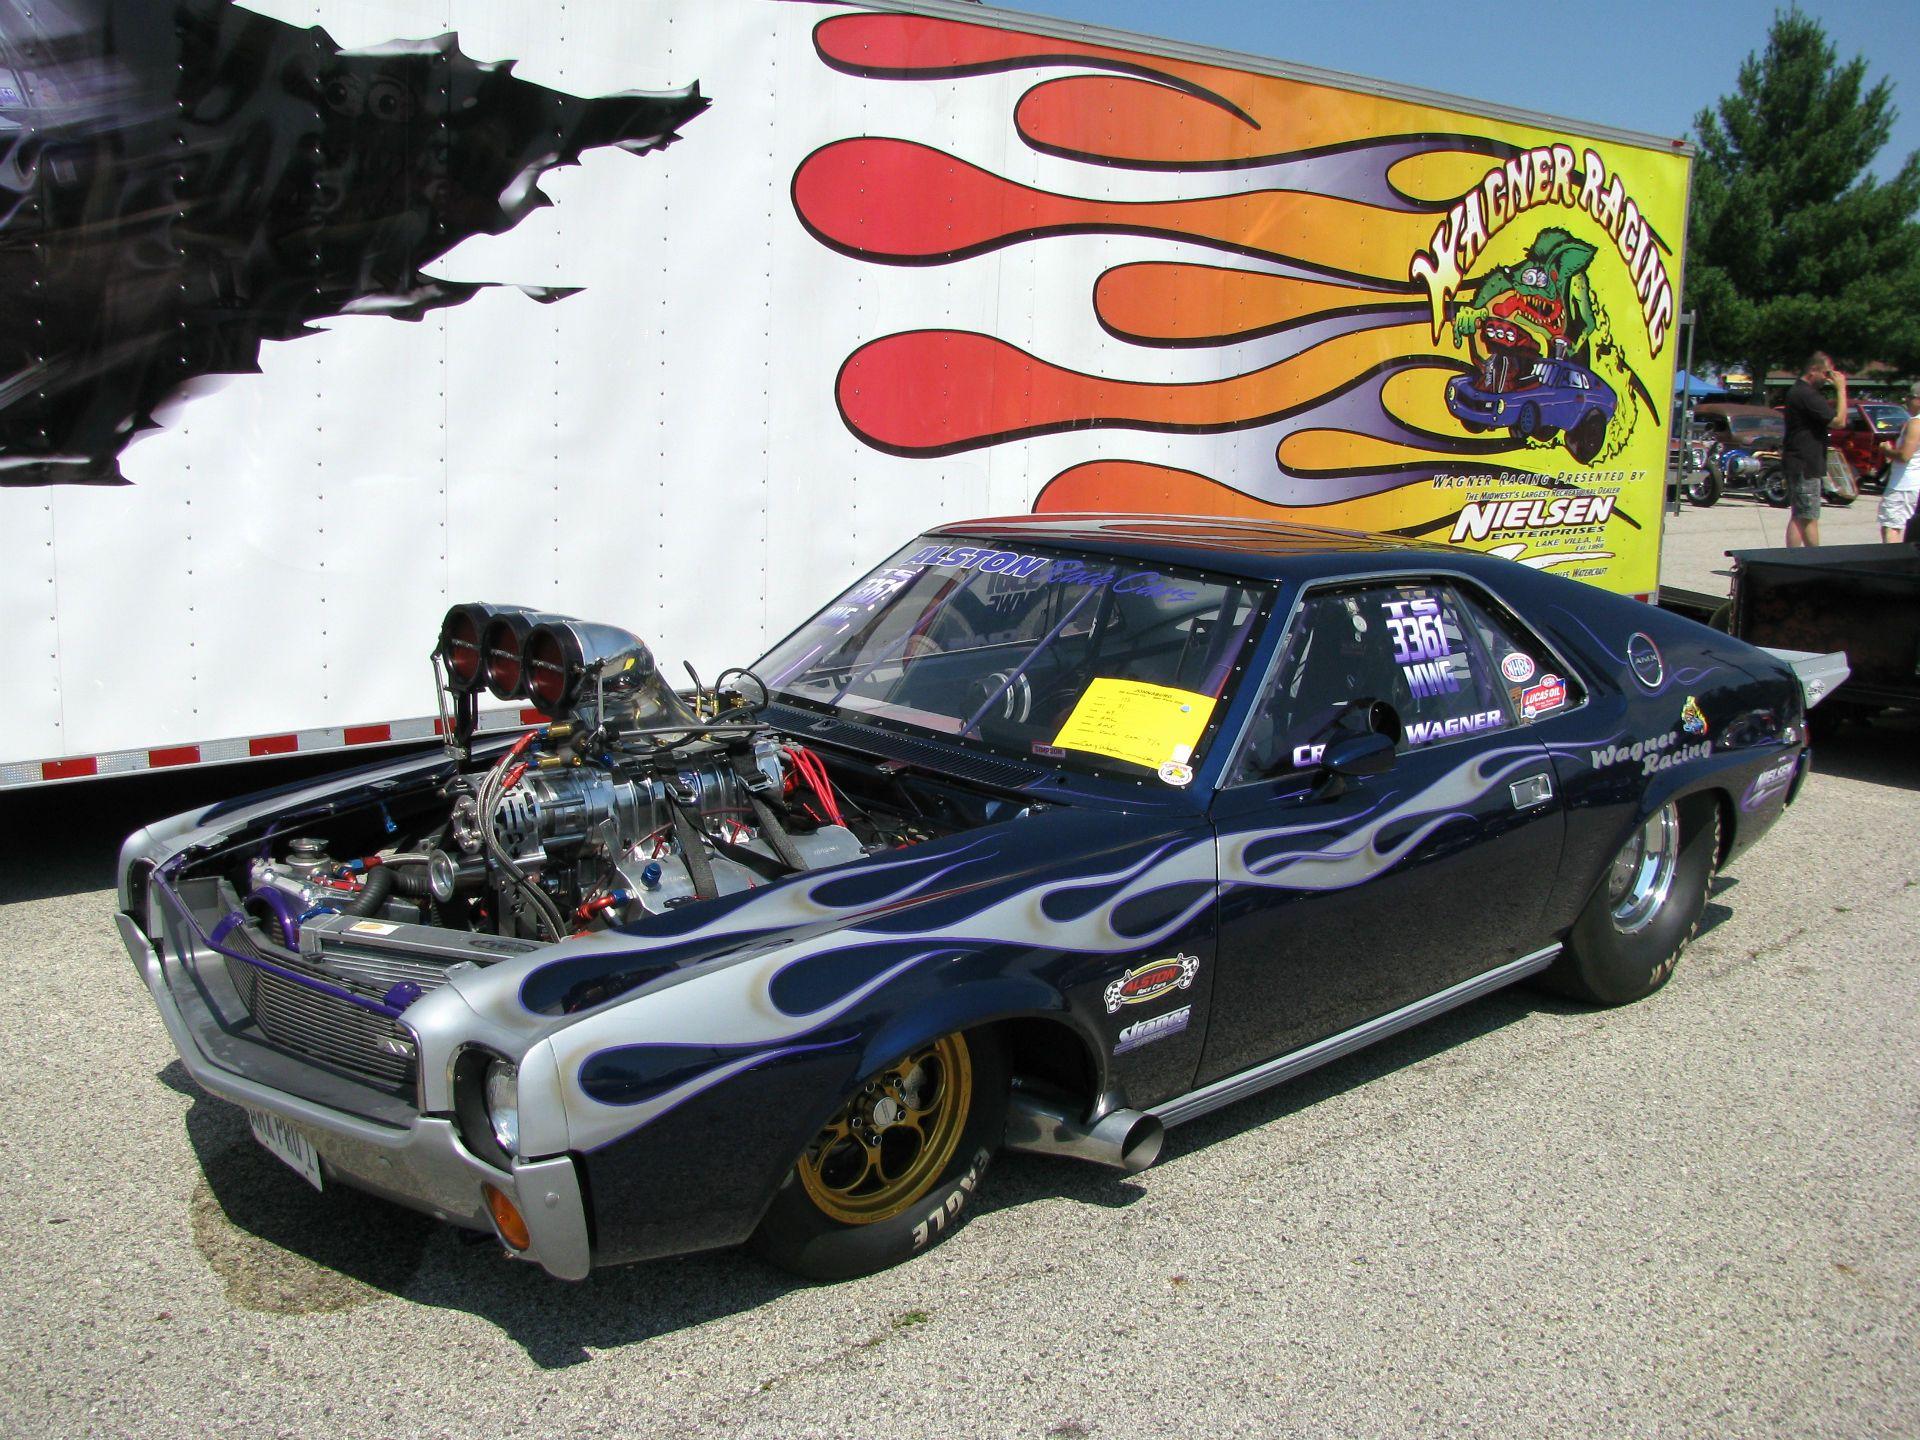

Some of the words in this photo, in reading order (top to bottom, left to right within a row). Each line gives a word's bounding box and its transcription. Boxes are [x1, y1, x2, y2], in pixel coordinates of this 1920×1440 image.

[1409, 143, 1575, 347] WAGNER
[1579, 148, 1673, 360] RACING
[1431, 474, 1492, 489] WAGNER
[1498, 472, 1550, 486] RACING
[1556, 471, 1624, 484] PRESENTED
[1630, 471, 1645, 481] BY
[1465, 492, 1478, 500] THE
[1480, 491, 1519, 500] MIDWEST'S
[1521, 490, 1550, 498] LARGEST
[1597, 486, 1620, 494] DEALER
[1449, 496, 1616, 543] NIELSEN
[1491, 526, 1605, 540] ENTERPRISES
[1536, 538, 1560, 547] LAKE
[898, 546, 1050, 578] ALSTON
[1572, 567, 1608, 578] WATERCRAFT
[1381, 598, 1438, 619] TS
[1386, 614, 1450, 664] 3361
[1506, 659, 1530, 676] NHRA
[1526, 689, 1549, 705] LUCAS
[1549, 687, 1560, 698] OIL
[1404, 709, 1503, 745] WAGNER
[1591, 731, 1678, 769] Wagner
[1641, 740, 1712, 776] Racing
[1124, 967, 1177, 993] ALSTON
